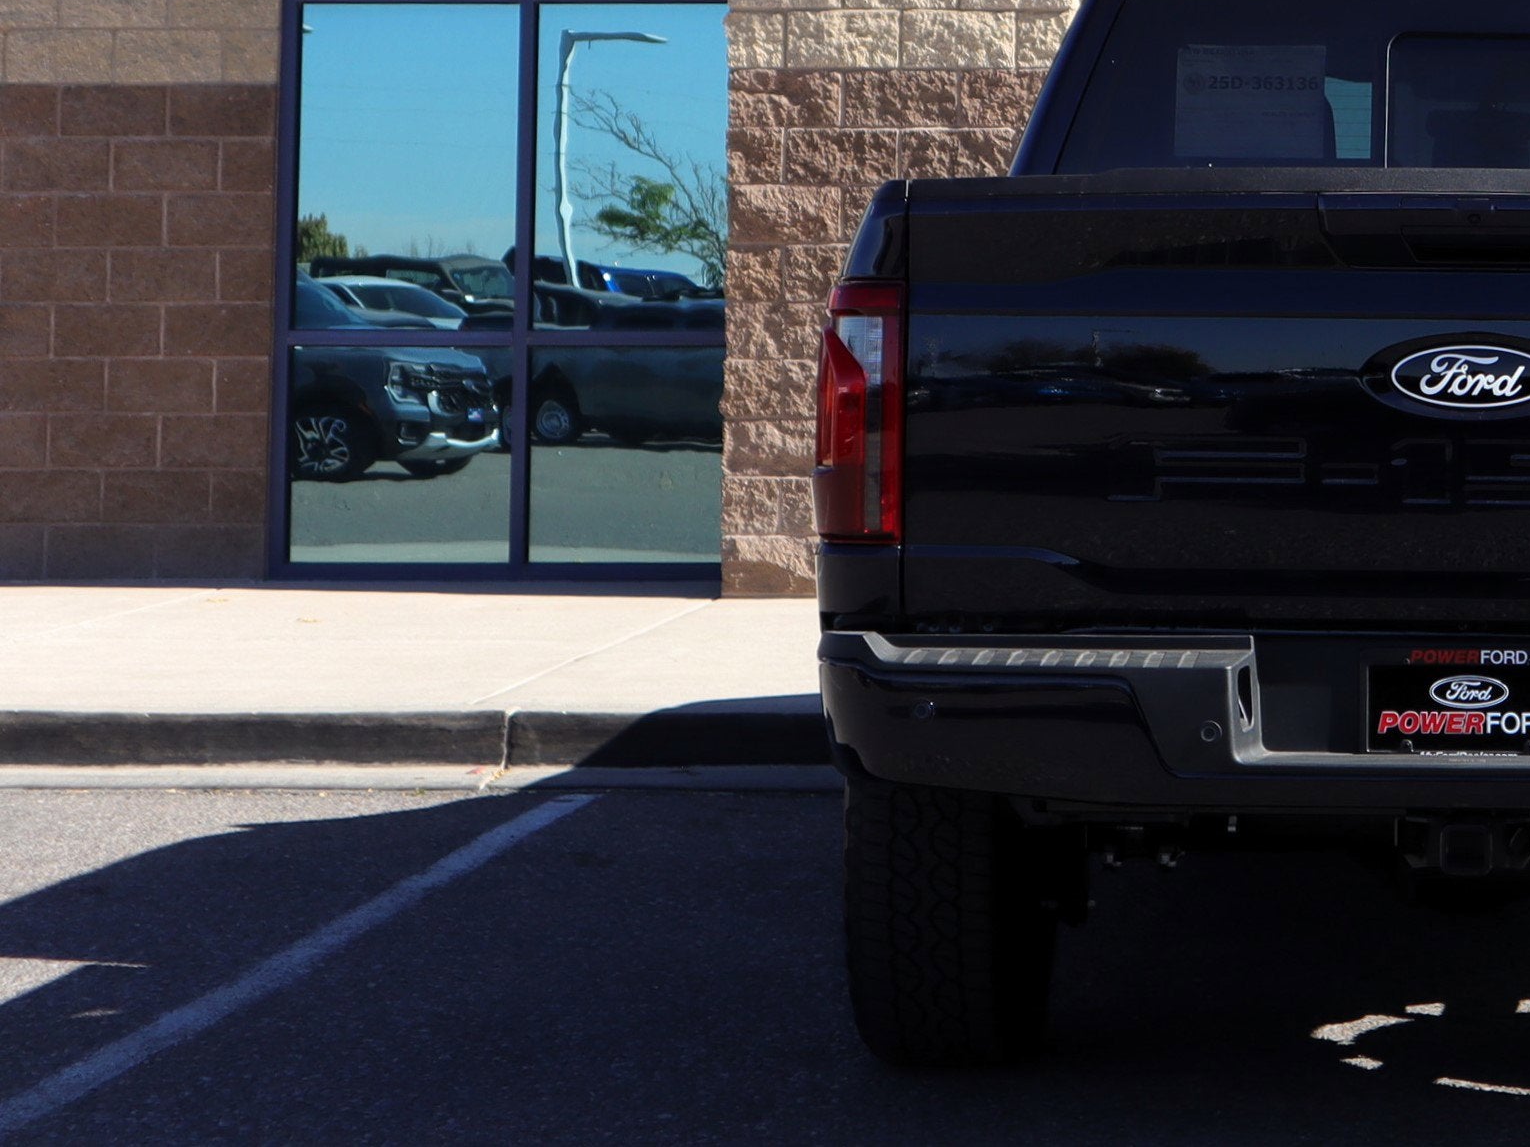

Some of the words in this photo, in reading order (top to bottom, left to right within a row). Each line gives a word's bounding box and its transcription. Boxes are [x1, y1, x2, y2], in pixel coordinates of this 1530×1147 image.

[1419, 353, 1526, 398] Ford
[1410, 649, 1529, 666] POWERFORD
[1445, 681, 1494, 702] Ford
